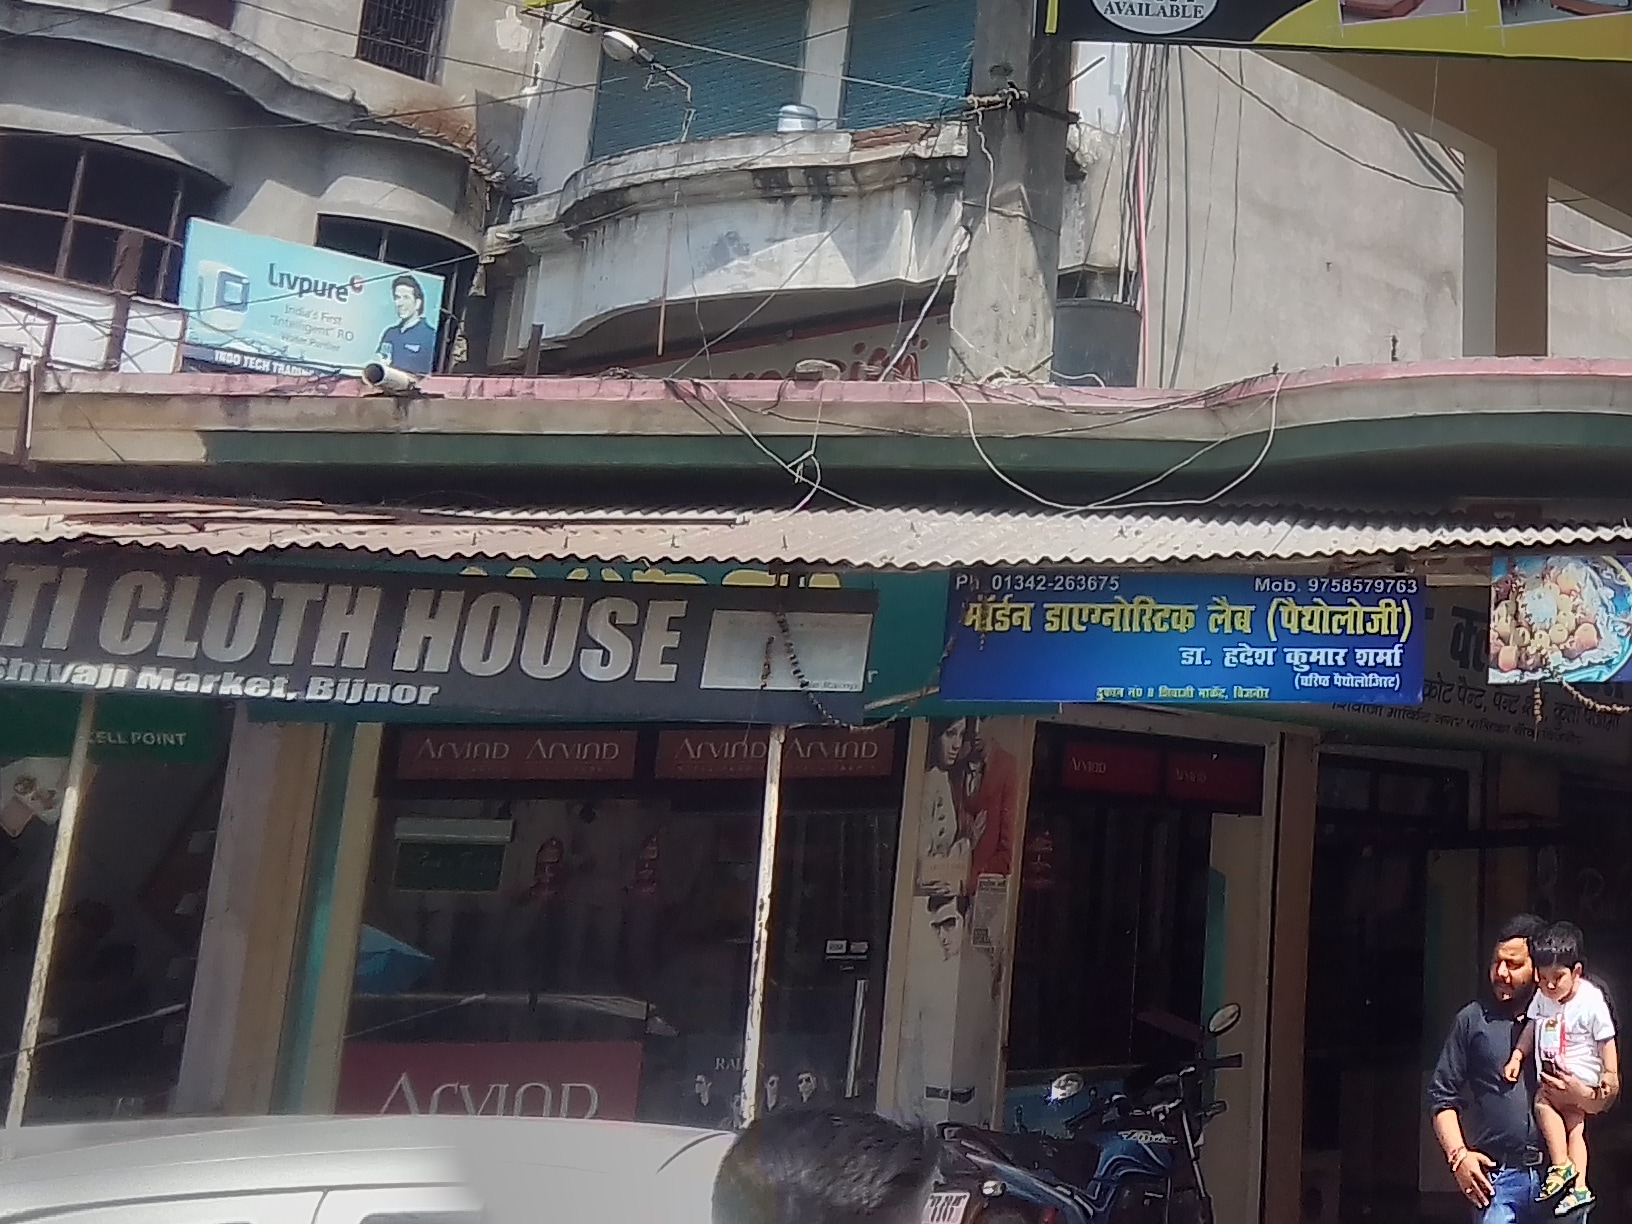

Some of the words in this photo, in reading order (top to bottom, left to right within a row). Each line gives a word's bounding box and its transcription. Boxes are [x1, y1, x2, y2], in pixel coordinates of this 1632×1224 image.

[1103, 1, 1205, 19] AVAILABLE
[268, 262, 349, 303] Livpure
[320, 311, 343, 325] First
[337, 328, 355, 342] RO
[243, 356, 271, 372] TECH
[991, 574, 1120, 591] 01342-263675
[1253, 577, 1301, 593] Mob.
[1307, 578, 1418, 594] 9758579763
[1207, 596, 1256, 635] लैब
[98, 569, 382, 669] CLOTH
[393, 588, 688, 682] HOUSE
[1283, 647, 1349, 672] कुमार
[1354, 643, 1404, 668] शर्मा
[135, 665, 299, 702] Market,
[304, 674, 441, 708] Bijnor
[130, 732, 188, 747] POINT
